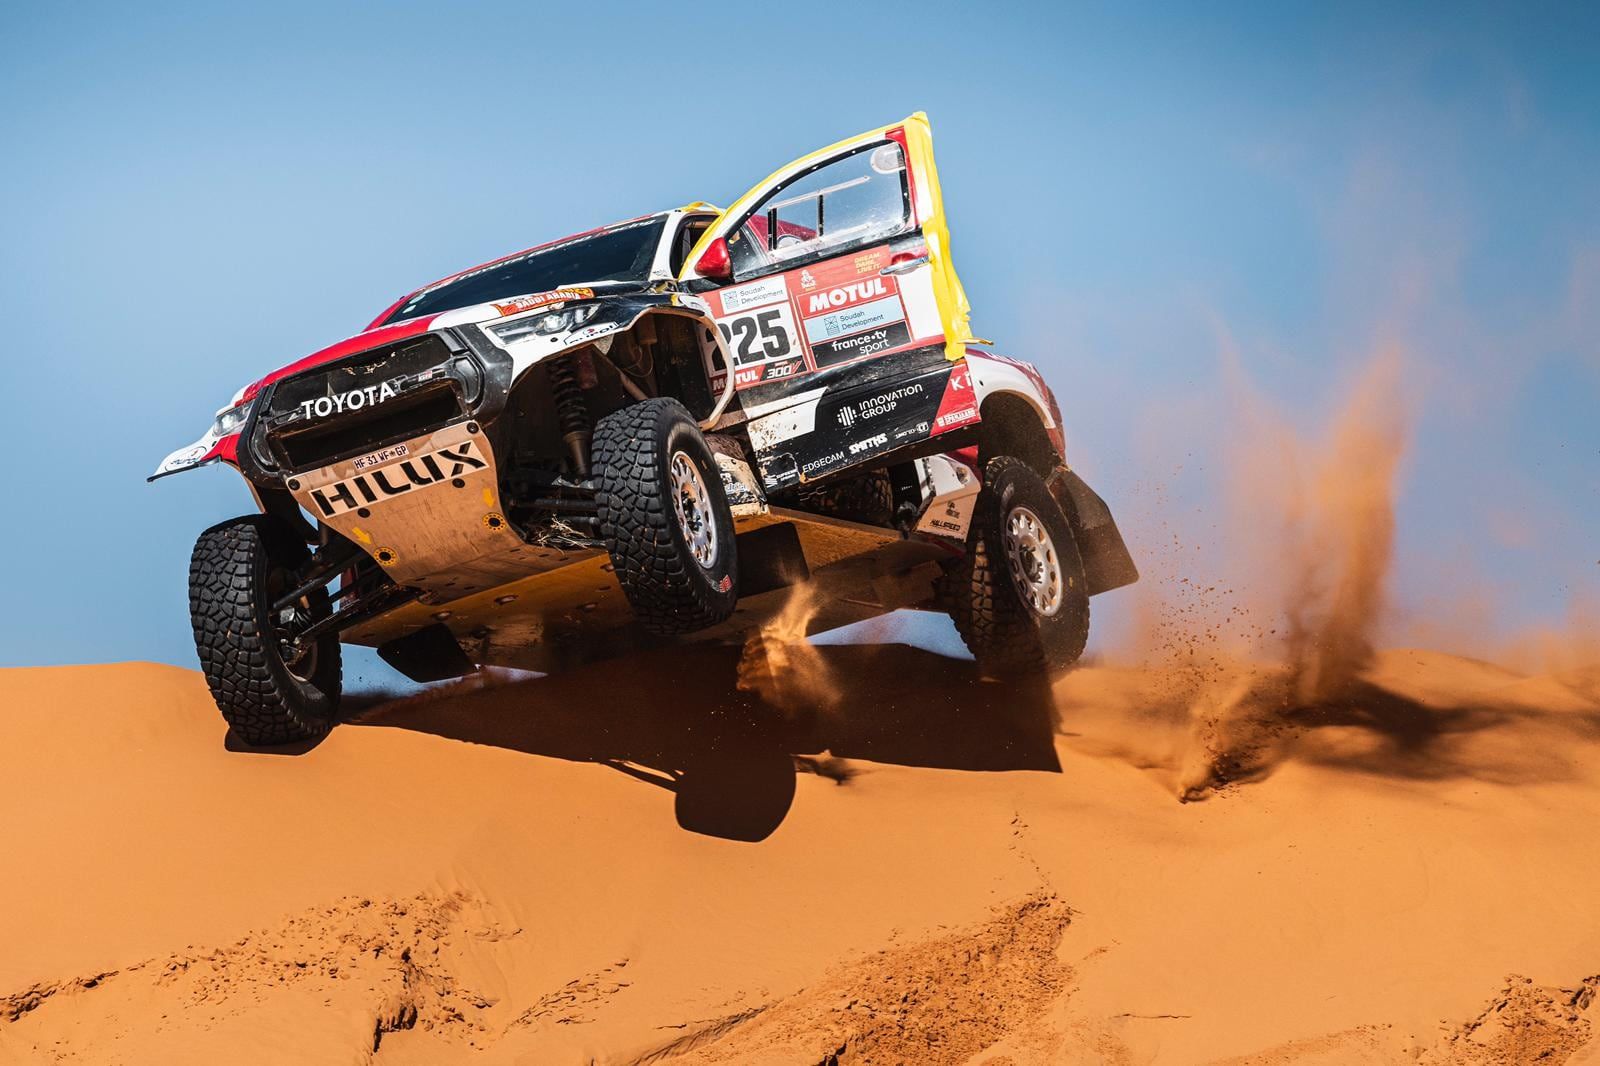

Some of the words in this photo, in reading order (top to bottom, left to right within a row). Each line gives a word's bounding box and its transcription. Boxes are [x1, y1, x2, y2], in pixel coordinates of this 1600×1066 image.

[740, 286, 766, 297] Soudah
[741, 289, 784, 305] Development
[809, 277, 887, 313] MOTUL
[840, 311, 865, 322] Soudah
[841, 314, 884, 330] Development
[859, 338, 890, 356] sport
[300, 381, 397, 420] TOYOTA
[861, 401, 897, 419] GROUP
[353, 459, 366, 470] HF
[367, 455, 379, 466] 31
[395, 445, 407, 456] GP
[802, 451, 845, 473] EDGECAM
[311, 442, 487, 517] HILUX
